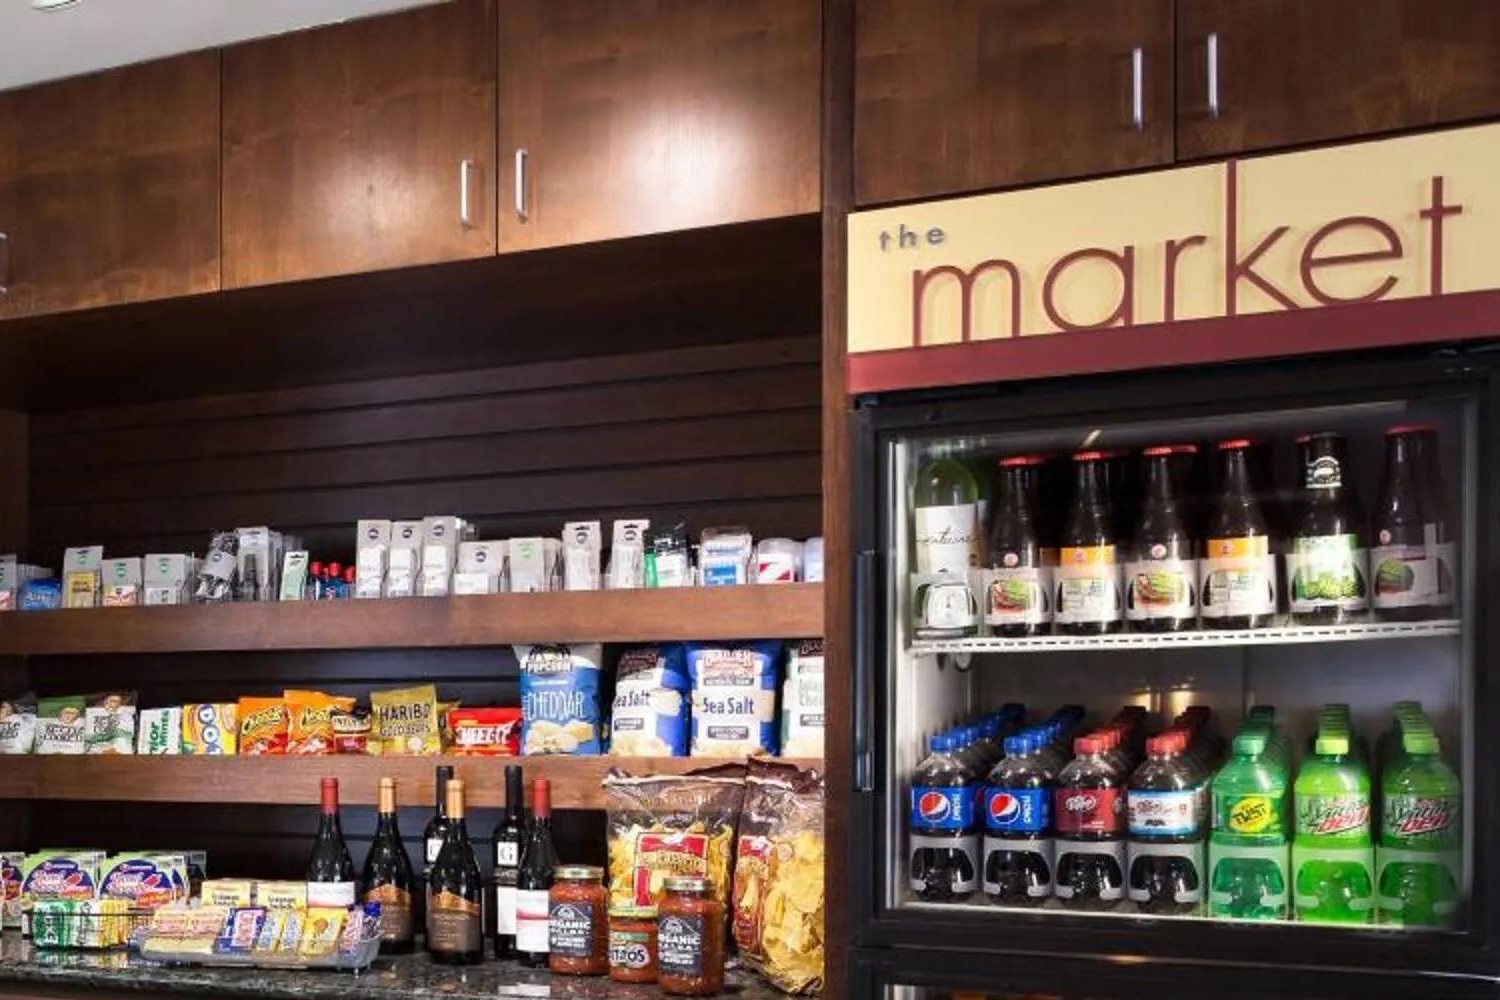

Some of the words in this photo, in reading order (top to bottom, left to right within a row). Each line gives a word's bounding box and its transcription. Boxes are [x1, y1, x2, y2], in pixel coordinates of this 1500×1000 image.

[879, 223, 946, 251] the
[912, 159, 1463, 347] market
[379, 703, 431, 721] HARIBO
[527, 690, 584, 722] CHEDDAR
[702, 697, 725, 714] Sea
[727, 697, 755, 715] Salt
[198, 705, 222, 755] DOT
[952, 793, 961, 821] pepsi
[1021, 795, 1032, 823] pepsi
